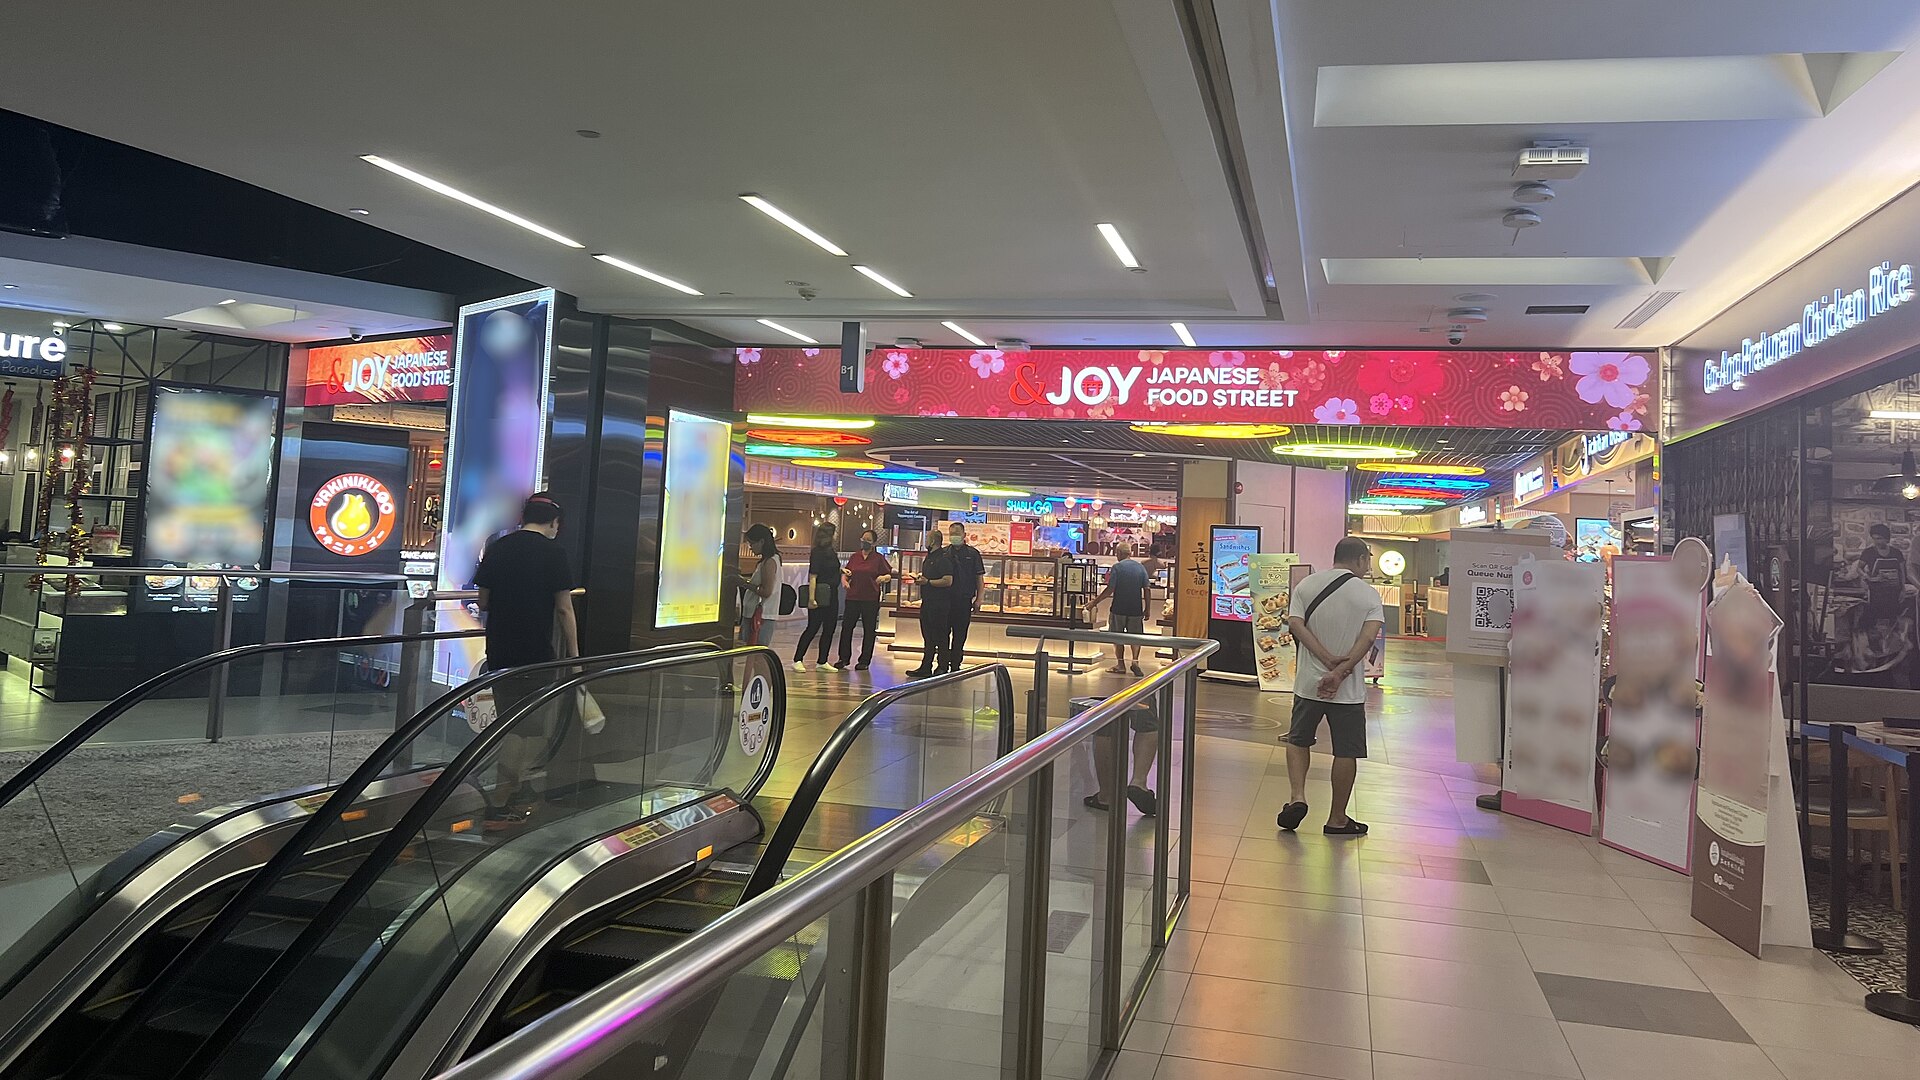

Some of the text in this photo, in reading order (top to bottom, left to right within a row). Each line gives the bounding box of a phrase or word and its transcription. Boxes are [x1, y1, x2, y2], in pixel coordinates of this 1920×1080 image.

[1742, 323, 1801, 376] Pratunam
[1803, 288, 1866, 348] Chicken
[1870, 261, 1913, 317] Rice
[2, 360, 57, 377] Paradise
[392, 350, 447, 369] JAPANESE
[391, 369, 450, 388] FOOD STRE
[841, 365, 853, 380] B1
[1147, 367, 1260, 385] JAPANESE
[1147, 389, 1298, 407] FOOD STREET
[1006, 499, 1053, 515] SHABU-GO
[1467, 569, 1494, 578] Queue
